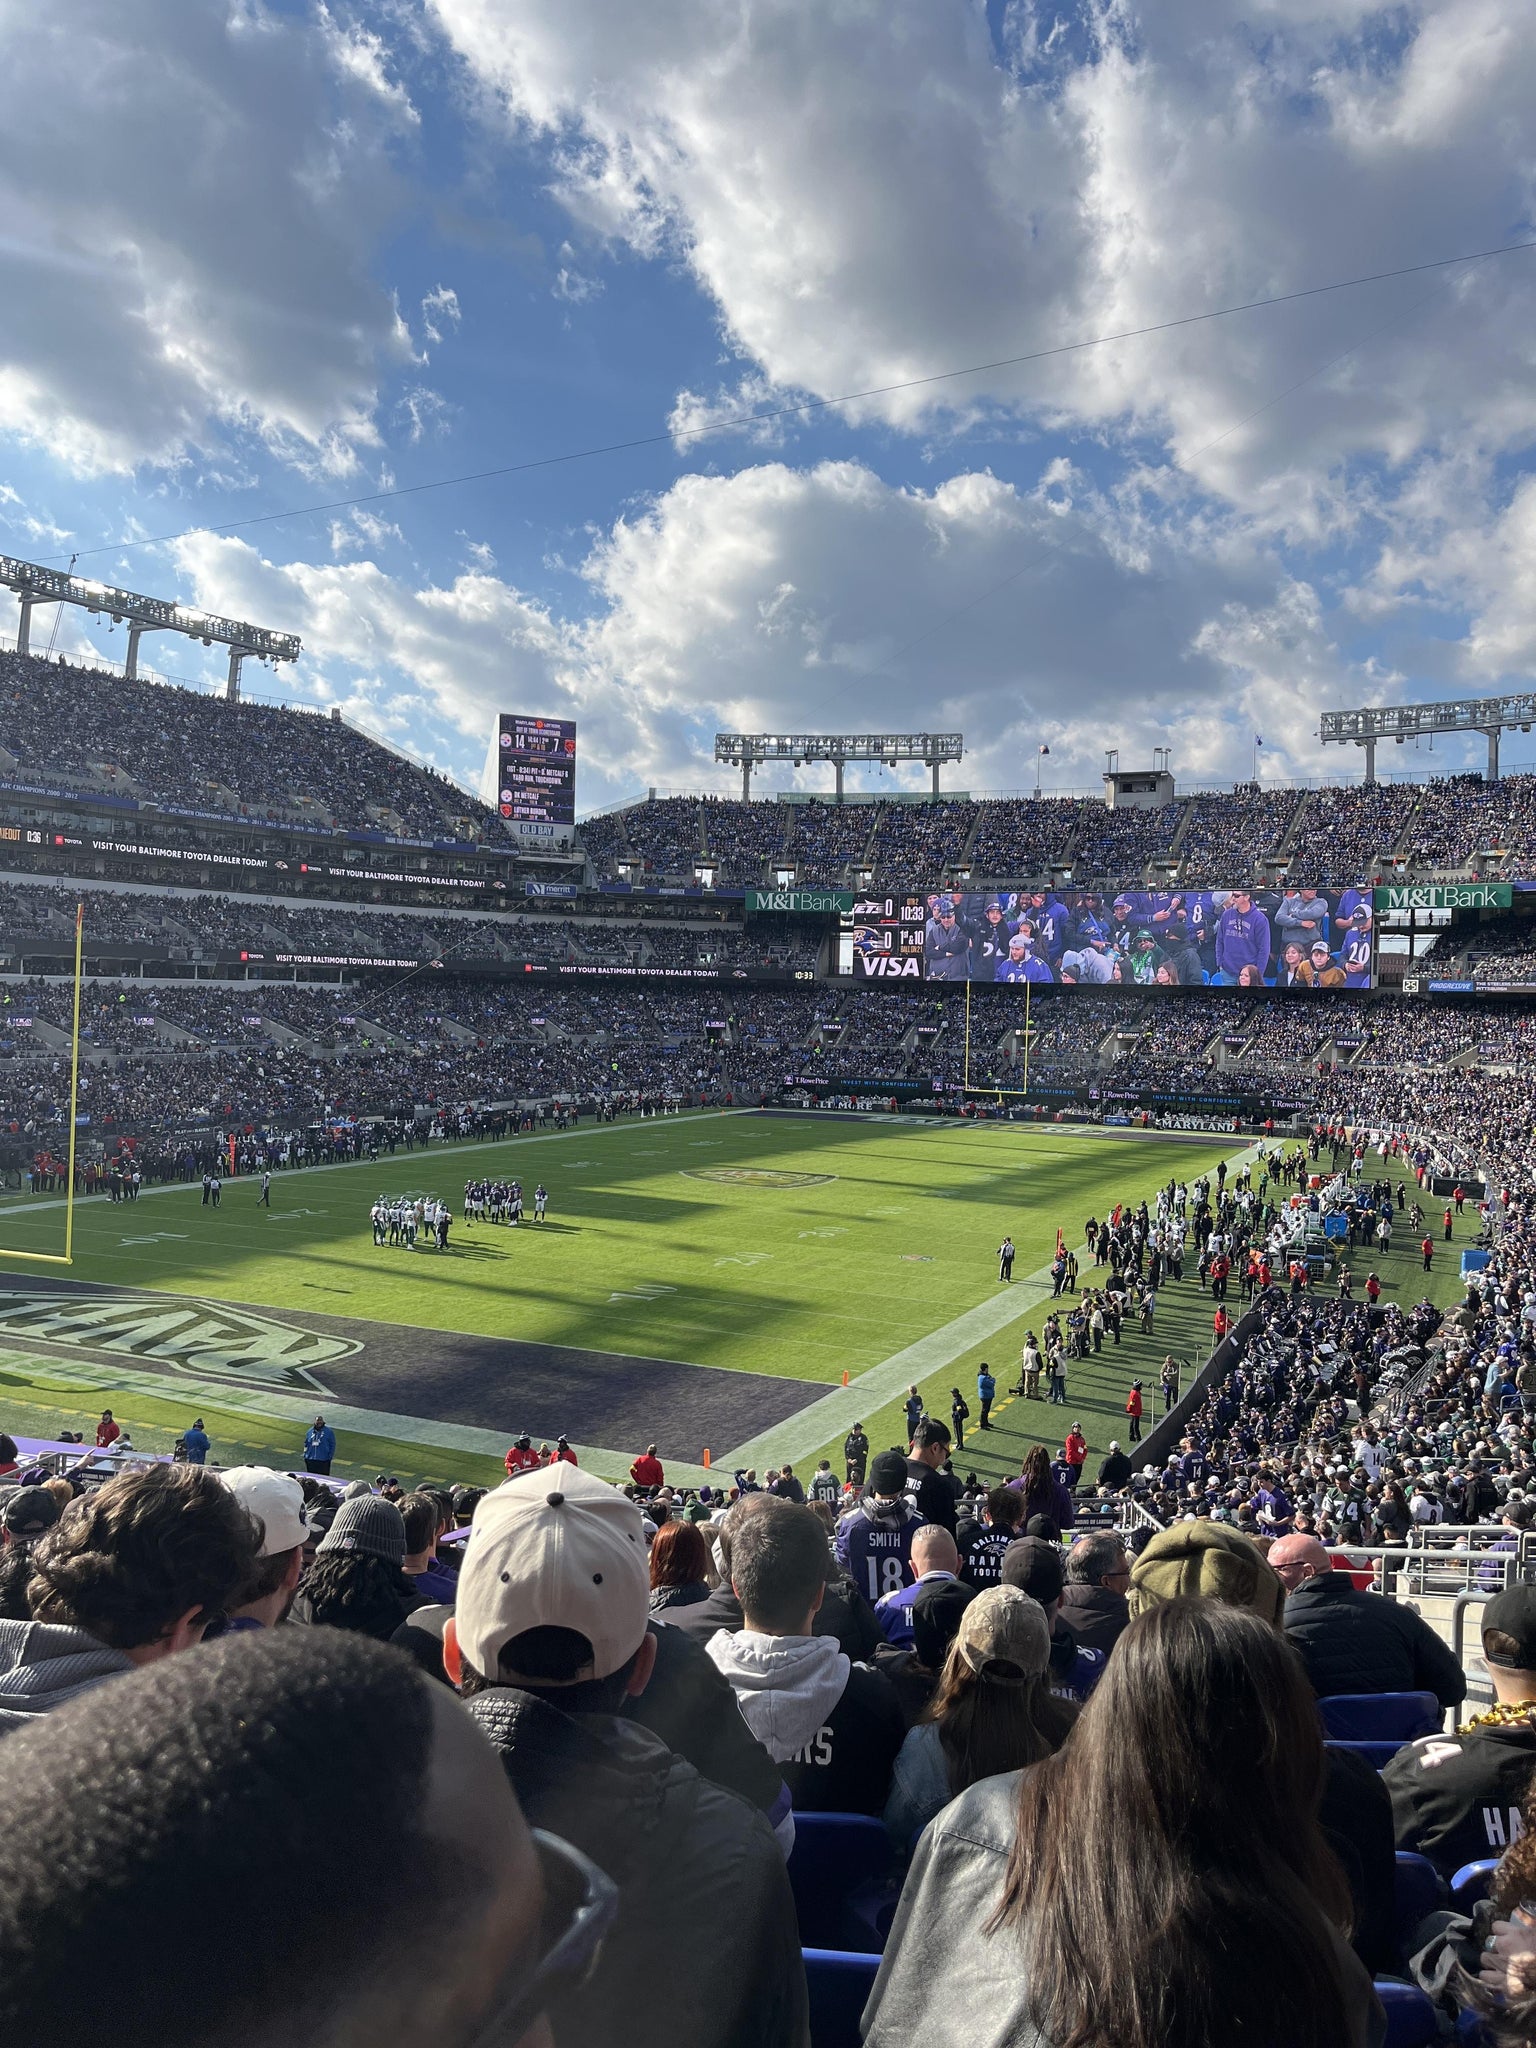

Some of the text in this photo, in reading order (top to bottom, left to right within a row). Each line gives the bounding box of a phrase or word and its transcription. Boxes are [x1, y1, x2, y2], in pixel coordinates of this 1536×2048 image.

[515, 734, 525, 749] 14
[554, 738, 559, 752] 7
[12, 784, 46, 796] CHAMPIONS
[195, 810, 222, 820] CHAMPIONS
[27, 830, 41, 844] 0:36
[522, 825, 552, 836] OLD BAY
[92, 840, 113, 851] VISIT
[115, 843, 137, 854] YOUR
[138, 846, 182, 859] BALTIMORE
[183, 851, 212, 862] TOYOTA
[213, 854, 241, 865] DEALER
[241, 858, 268, 868] TODAY!
[329, 867, 346, 876] VISIT
[346, 869, 364, 878] YOUR
[364, 871, 404, 882] BALTIMORE
[404, 874, 430, 884] TOYOTA
[431, 876, 458, 886] DEALER
[459, 879, 485, 888] TODAY!
[546, 885, 571, 894] merritt
[755, 892, 842, 911] M&T Bank
[1387, 886, 1498, 909] M&T Bank
[900, 906, 924, 921] 10:33
[1192, 904, 1203, 924] 8
[1350, 941, 1370, 966] 20
[275, 954, 292, 962] VISIT
[294, 955, 312, 963] YOUR
[312, 956, 347, 965] BALTIMORE
[348, 957, 372, 966] TOYOTA
[373, 959, 396, 967] DEALER
[397, 960, 418, 968] TODAY!
[863, 957, 920, 977] VISA
[578, 966, 597, 974] YOUR
[597, 967, 636, 975] BALTIMORE
[637, 968, 664, 976] TOYOTA
[665, 969, 692, 977] DEALER
[795, 971, 813, 979] 10:33
[1406, 982, 1417, 990] 25
[1428, 982, 1472, 990] PROGRESSIVE
[1162, 1119, 1236, 1133] MARYLAND
[1372, 1452, 1381, 1466] 14
[1060, 1472, 1066, 1484] 8
[869, 1532, 900, 1548] SMITH
[866, 1555, 903, 1600] 18
